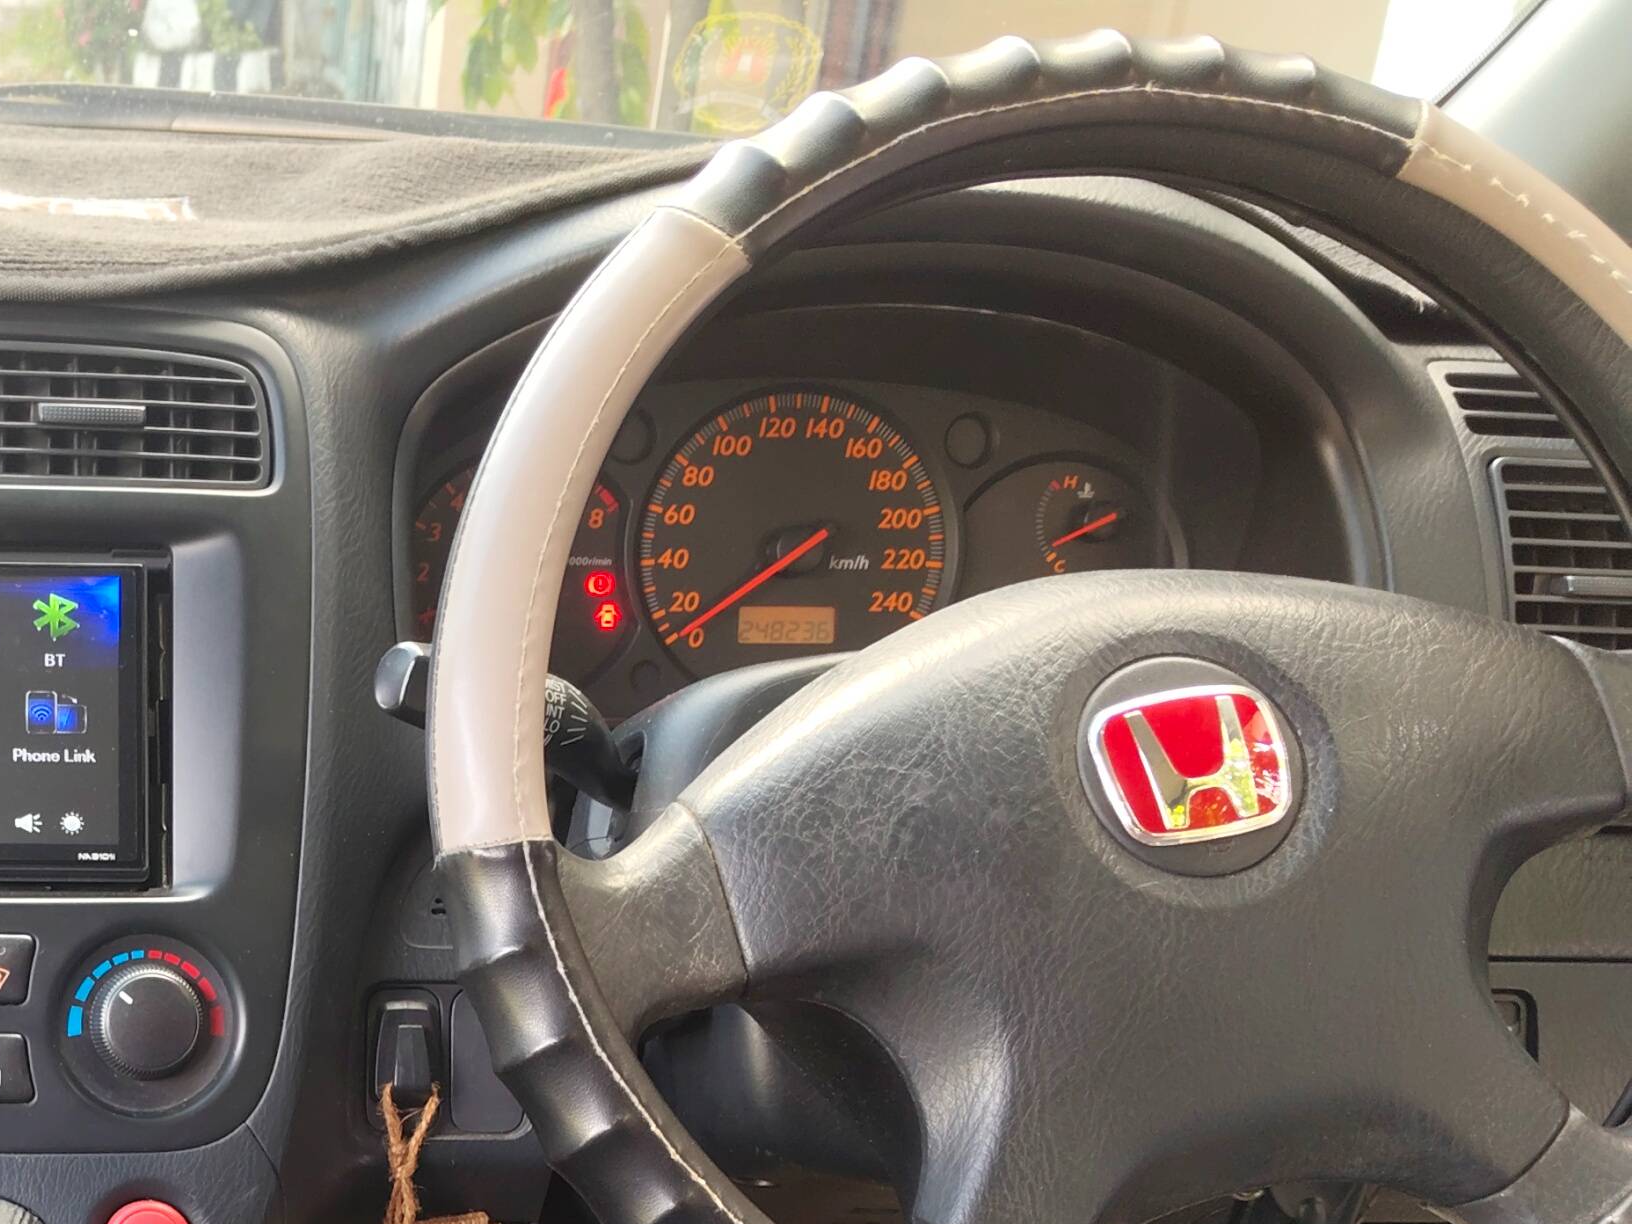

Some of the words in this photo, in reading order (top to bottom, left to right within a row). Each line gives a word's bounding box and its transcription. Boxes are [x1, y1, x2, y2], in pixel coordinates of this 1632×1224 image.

[759, 417, 797, 439] 120
[805, 417, 846, 439] 140
[712, 435, 753, 458] 100
[844, 437, 884, 459] 160
[681, 465, 715, 488] 80
[867, 469, 908, 492] 180
[1064, 475, 1078, 489] H
[588, 507, 604, 529] 8
[663, 504, 696, 526] 60
[877, 508, 923, 530] 200
[657, 548, 690, 570] 40
[828, 555, 870, 571] km/h
[880, 549, 926, 571] 220
[1053, 560, 1067, 573] C
[669, 591, 701, 613] 20
[868, 592, 913, 614] 240
[688, 627, 704, 649] 0
[44, 653, 66, 668] BT
[12, 748, 61, 763] Phone
[64, 749, 96, 763] Link
